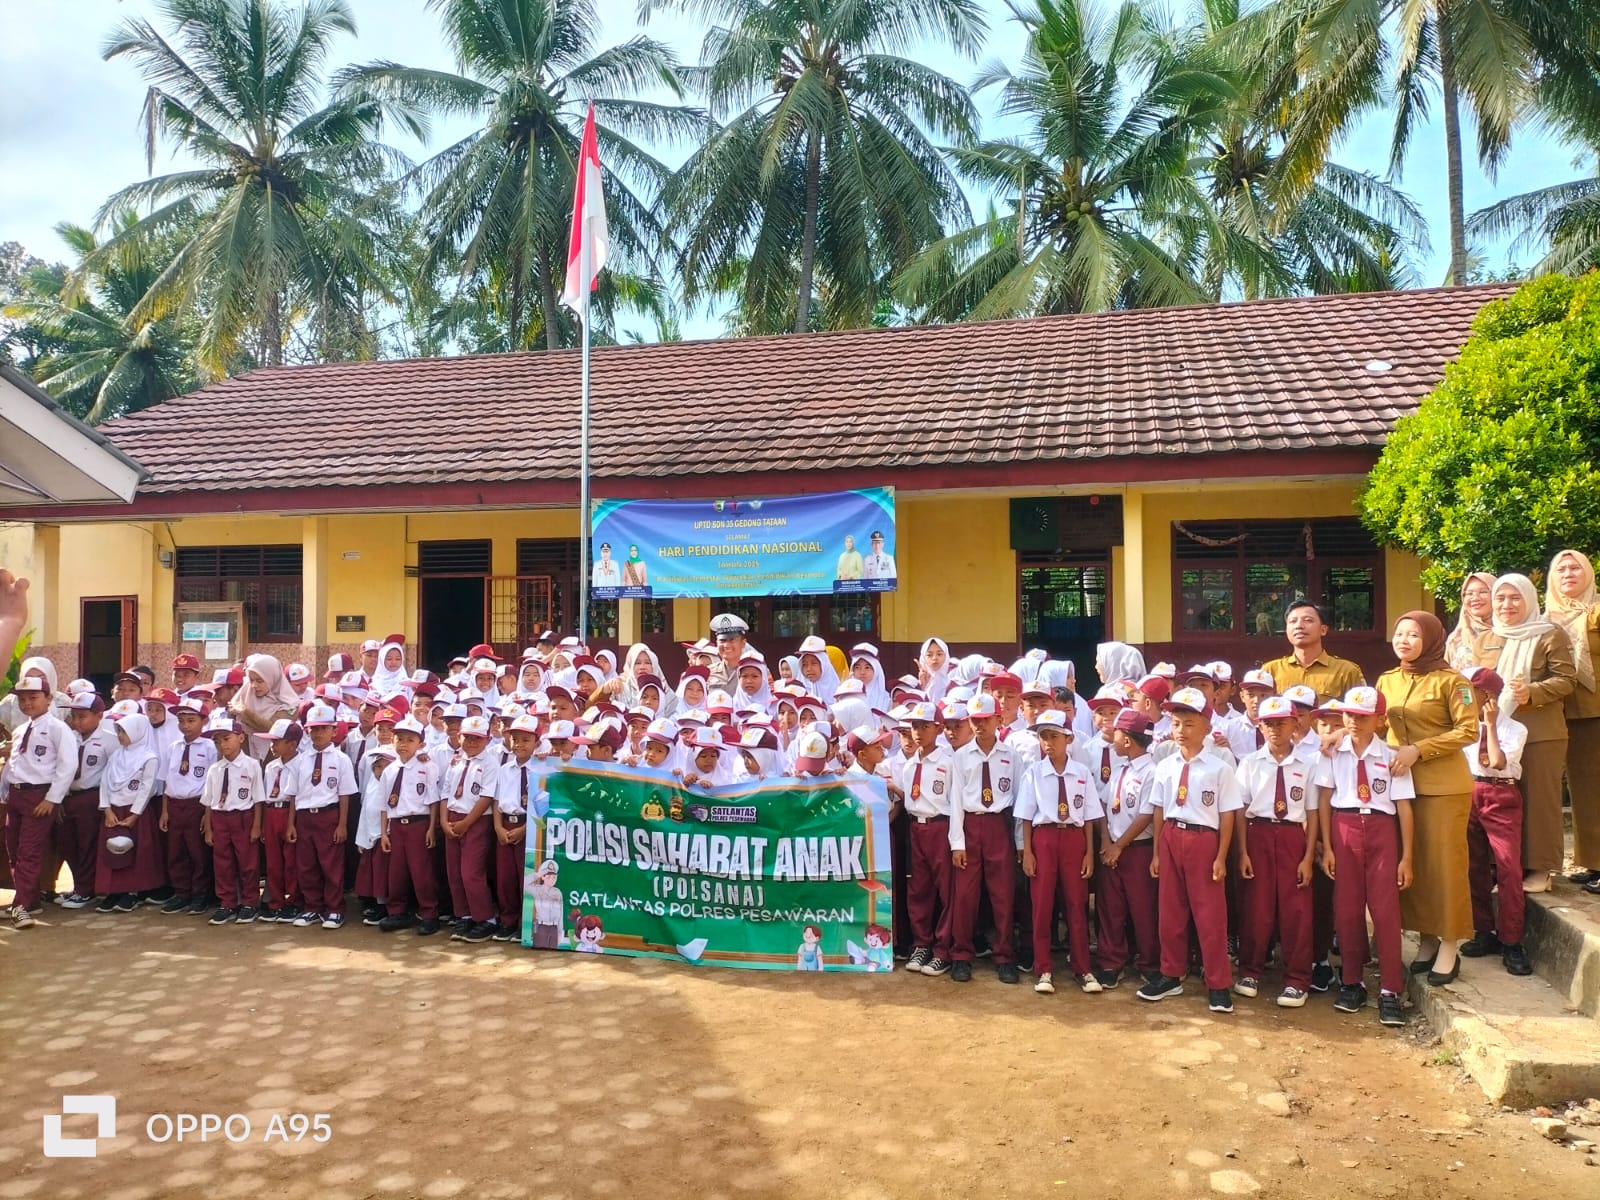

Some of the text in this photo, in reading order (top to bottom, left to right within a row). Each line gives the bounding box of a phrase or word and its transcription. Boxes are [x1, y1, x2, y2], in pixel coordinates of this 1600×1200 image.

[694, 520, 711, 529] UPTD
[712, 519, 725, 529] SDN
[735, 518, 762, 528] GEDONG
[763, 517, 787, 527] TATAAN
[658, 541, 823, 557] HARI PENDIDIKAN NASIONAL
[712, 807, 756, 817] SATLANTAS
[545, 816, 867, 882] POLISI SAHABAT ANAK
[653, 876, 765, 908] (POLSANA)
[568, 890, 855, 923] SATLANTAS POLRES PESAWARAN
